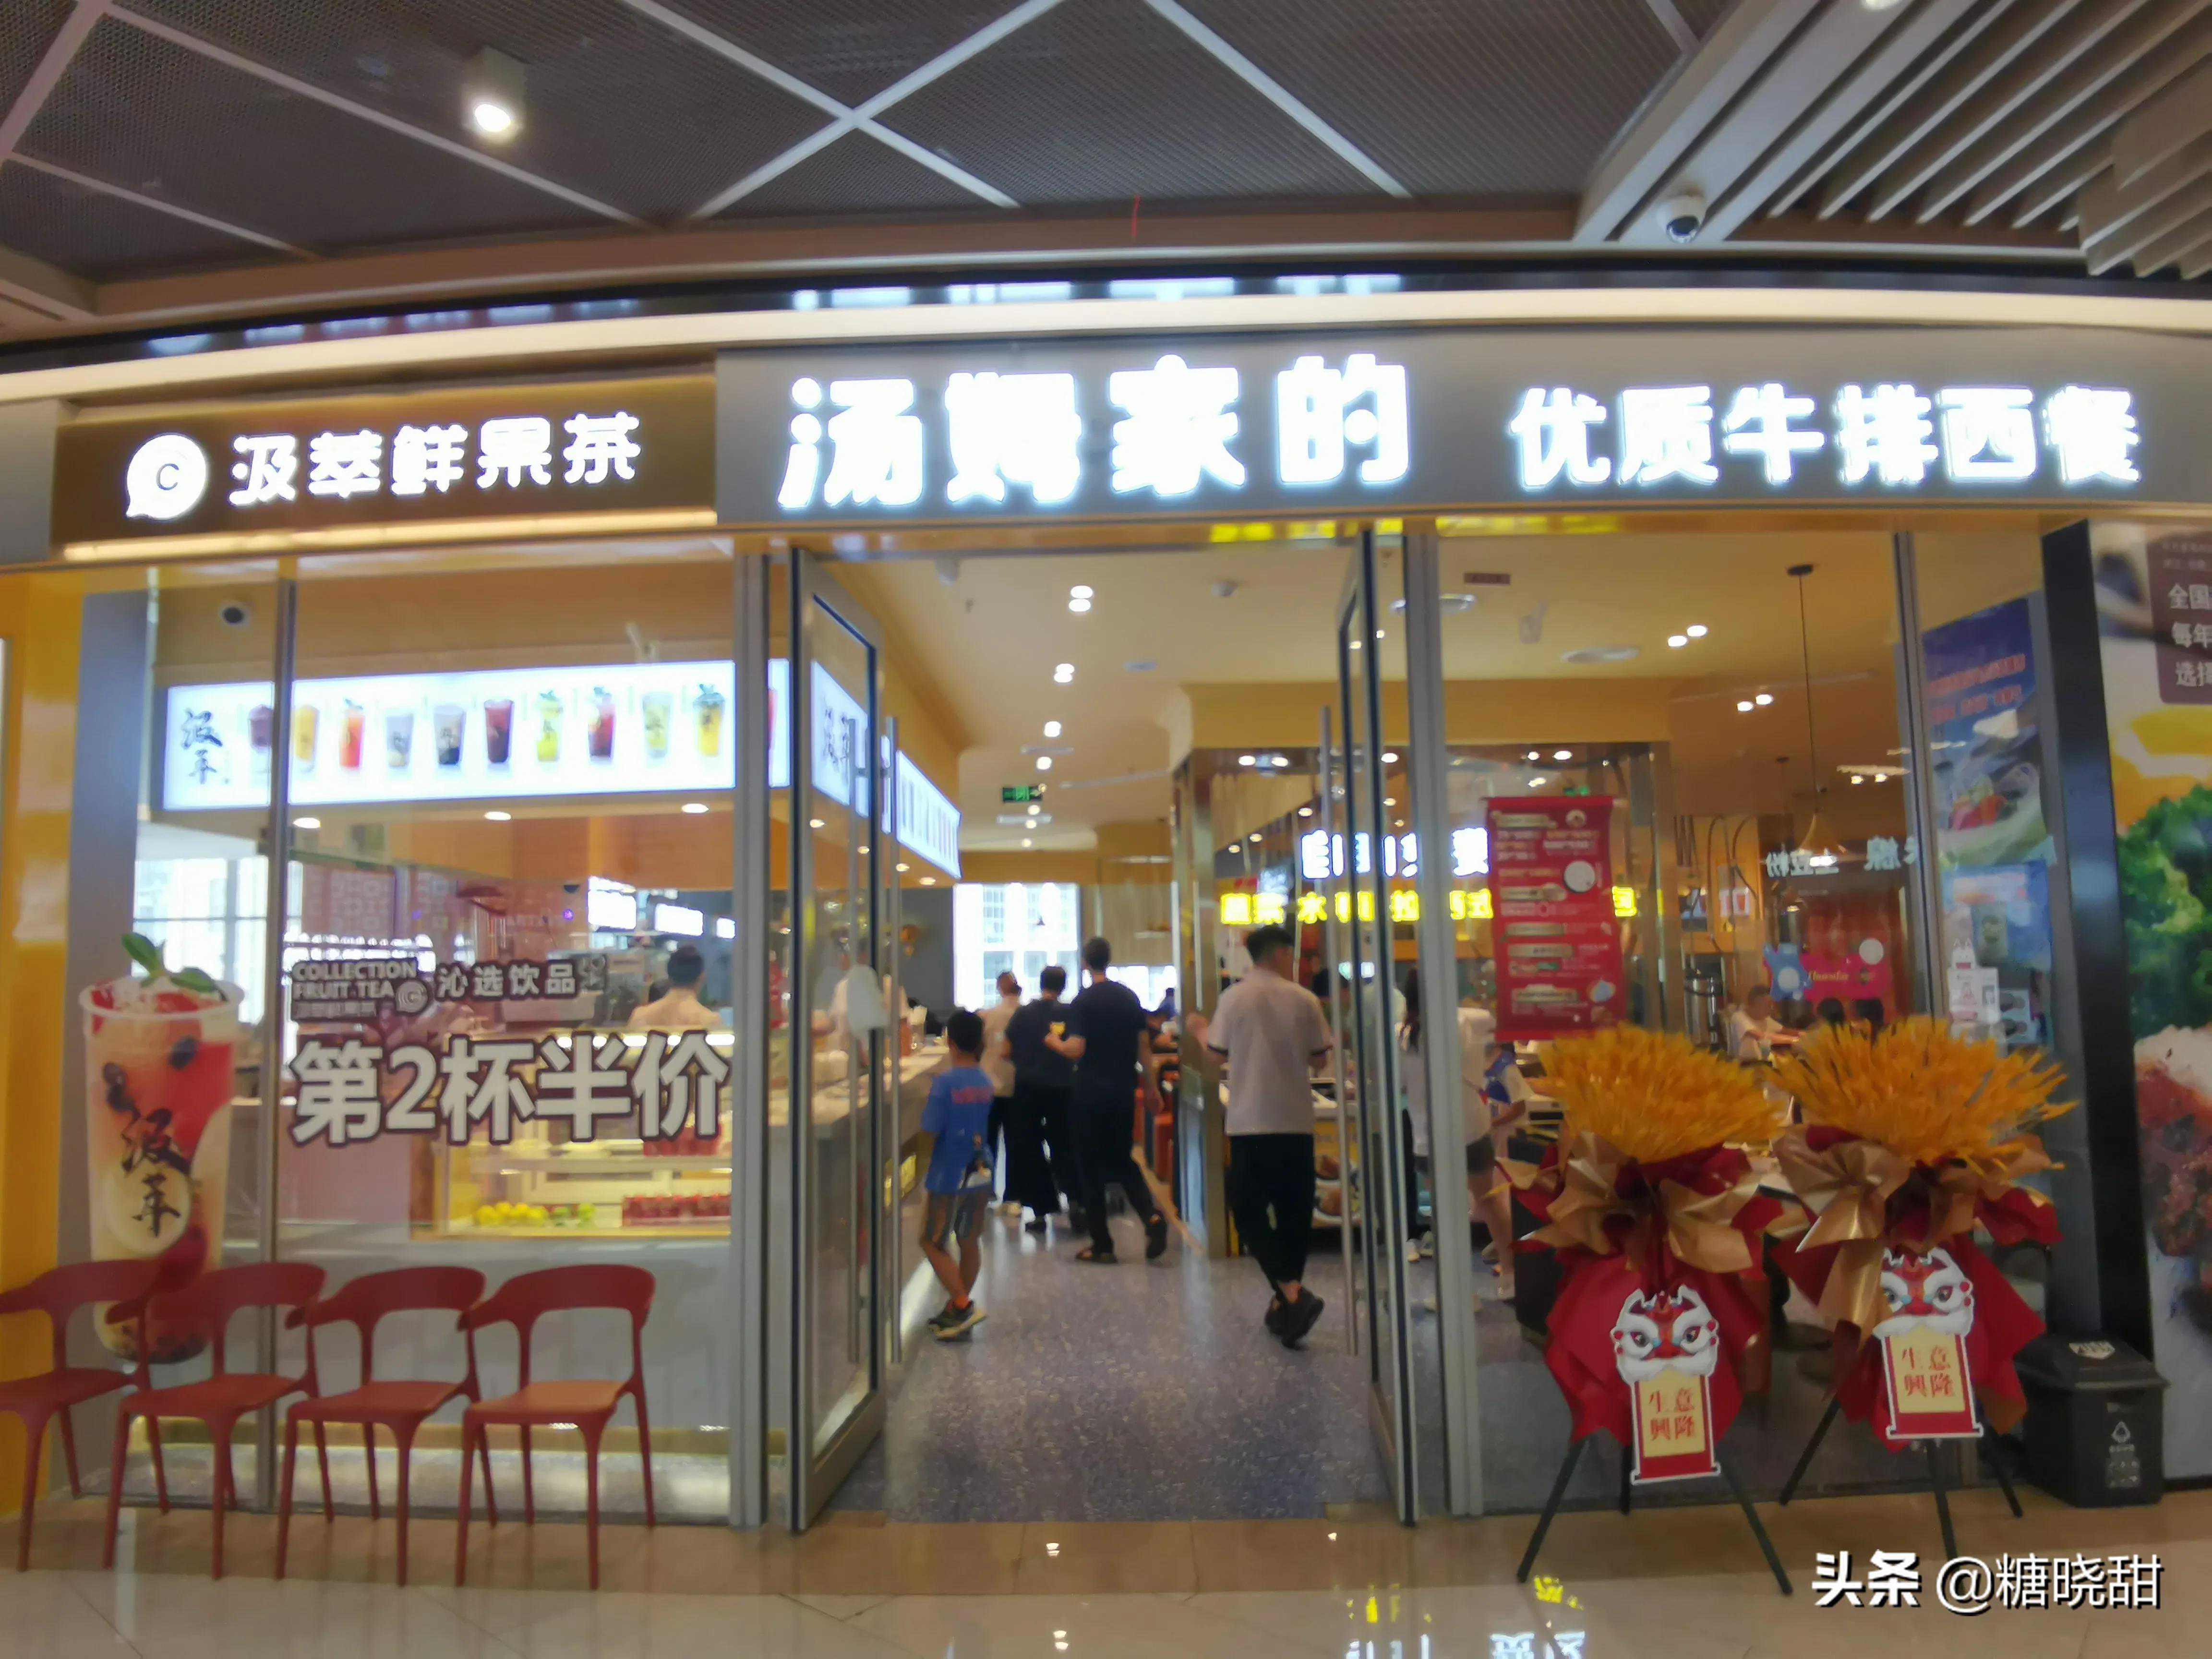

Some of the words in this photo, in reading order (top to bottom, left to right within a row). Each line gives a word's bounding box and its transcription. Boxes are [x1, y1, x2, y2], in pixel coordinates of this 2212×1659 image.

[228, 410, 641, 506] 汲萃鲜果茶
[777, 353, 1409, 509] 汤姆家的
[1508, 383, 2141, 487] 优质牛排西餐
[291, 960, 418, 981] COLLECTION
[357, 980, 395, 999] TEA
[290, 1031, 730, 1146] 第2杯半价
